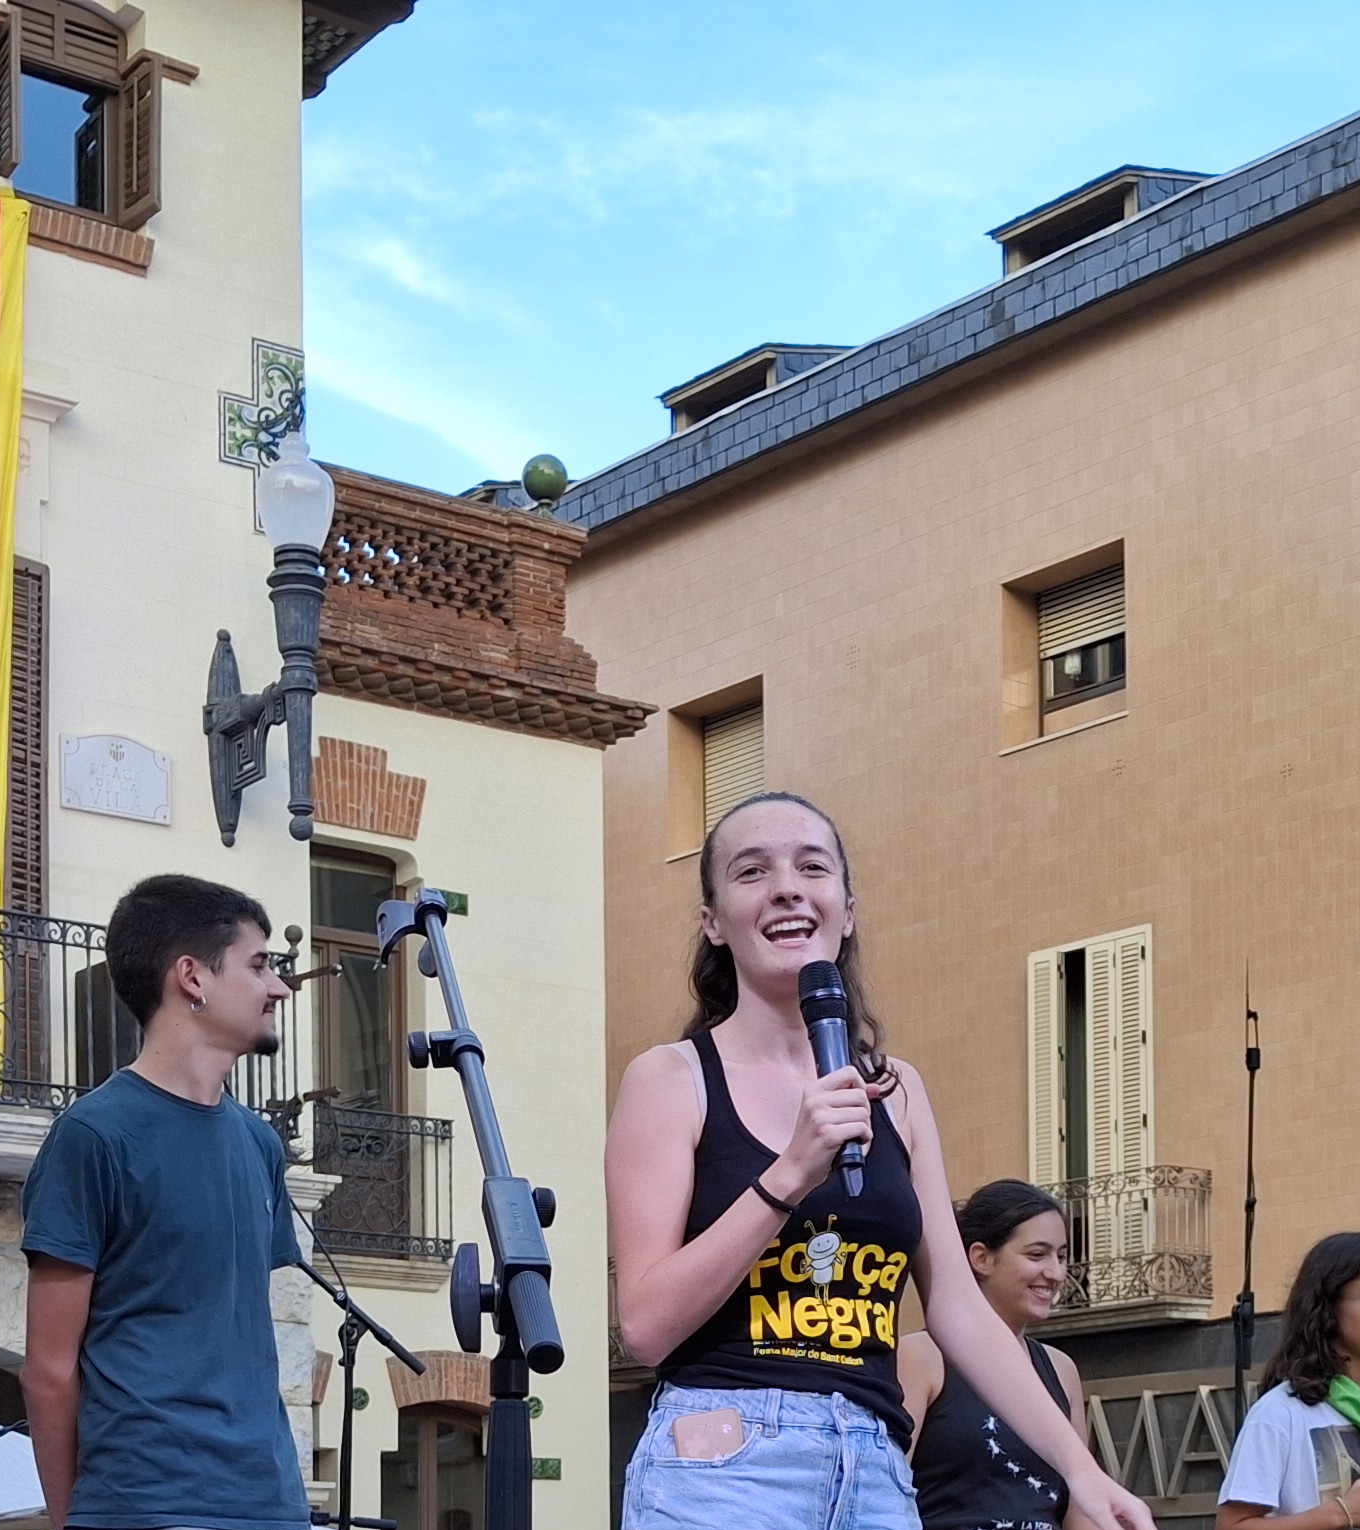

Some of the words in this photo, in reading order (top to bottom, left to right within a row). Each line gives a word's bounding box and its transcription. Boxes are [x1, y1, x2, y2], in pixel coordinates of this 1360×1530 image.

[90, 787, 144, 812] VILA
[749, 1239, 908, 1296] Força
[750, 1291, 896, 1349] Negra!
